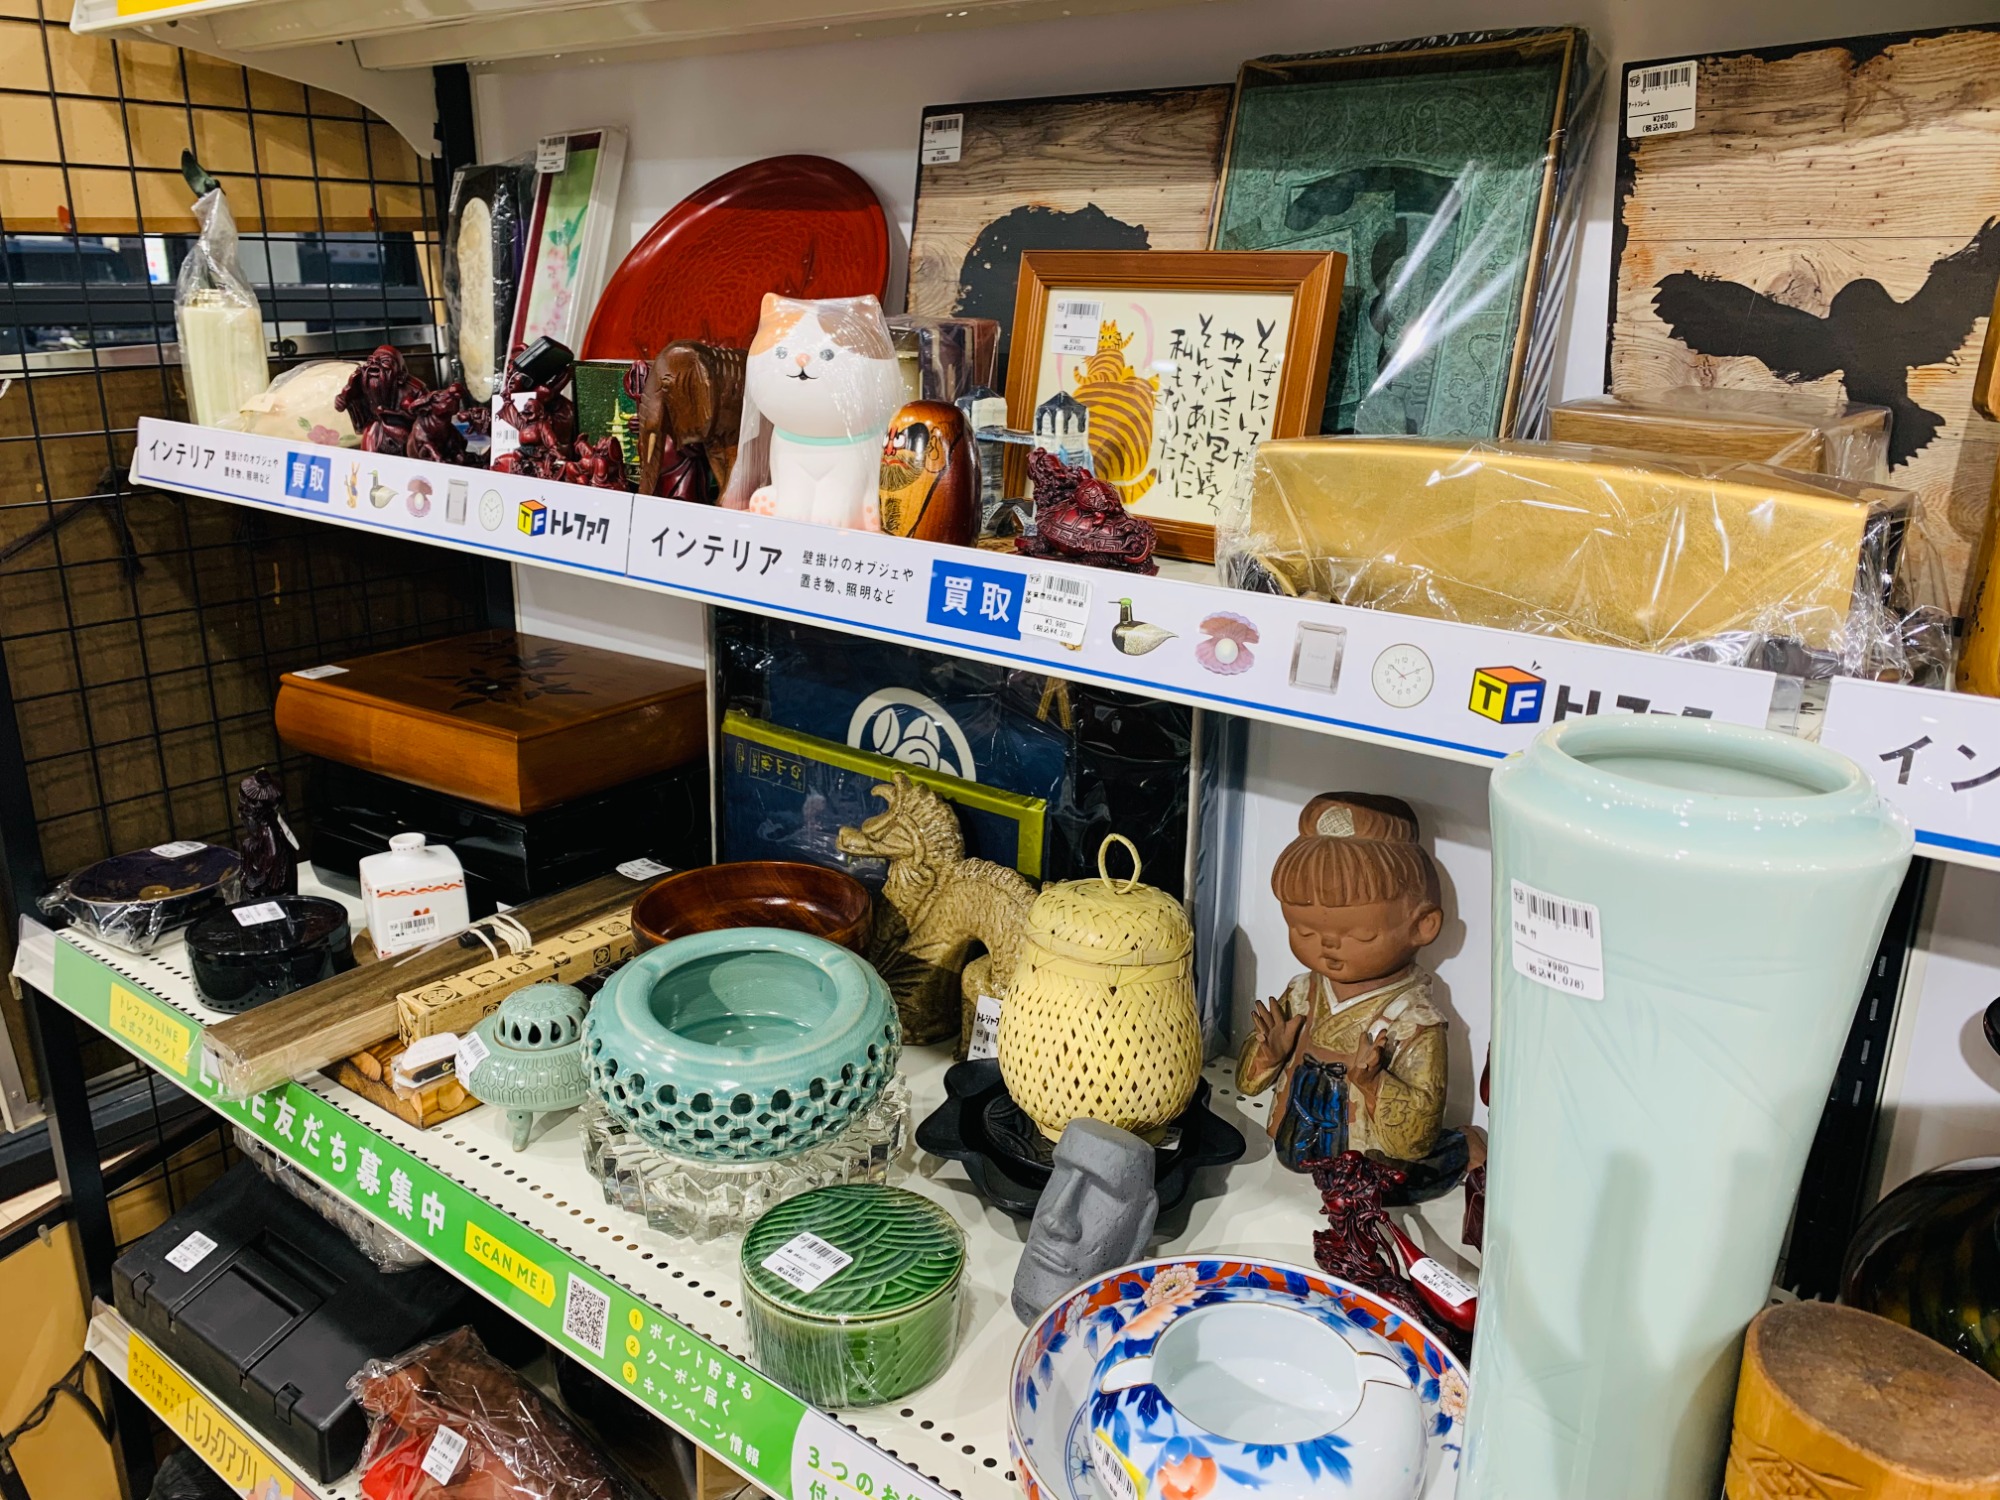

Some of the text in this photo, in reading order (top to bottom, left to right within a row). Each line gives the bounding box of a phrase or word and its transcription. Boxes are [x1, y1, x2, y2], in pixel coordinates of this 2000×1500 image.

[1653, 114, 1669, 122] ¥280
[1158, 329, 1193, 485] 私もなりたい
[1175, 313, 1214, 498] そんなあなたに
[150, 439, 215, 469] インテリア
[225, 450, 279, 468] 壁掛けのオブジェや
[292, 462, 324, 491] 買取
[651, 526, 783, 576] インテリア
[801, 549, 915, 583] 壁掛けのオブジェや
[799, 572, 897, 605] 置き物、照明など
[942, 577, 1013, 623] 買取
[473, 1235, 512, 1273] SCAN
[646, 1349, 730, 1416] クーポン届く
[649, 1323, 752, 1400] ポイント貯まる
[643, 1377, 760, 1468] キャンペーン情報
